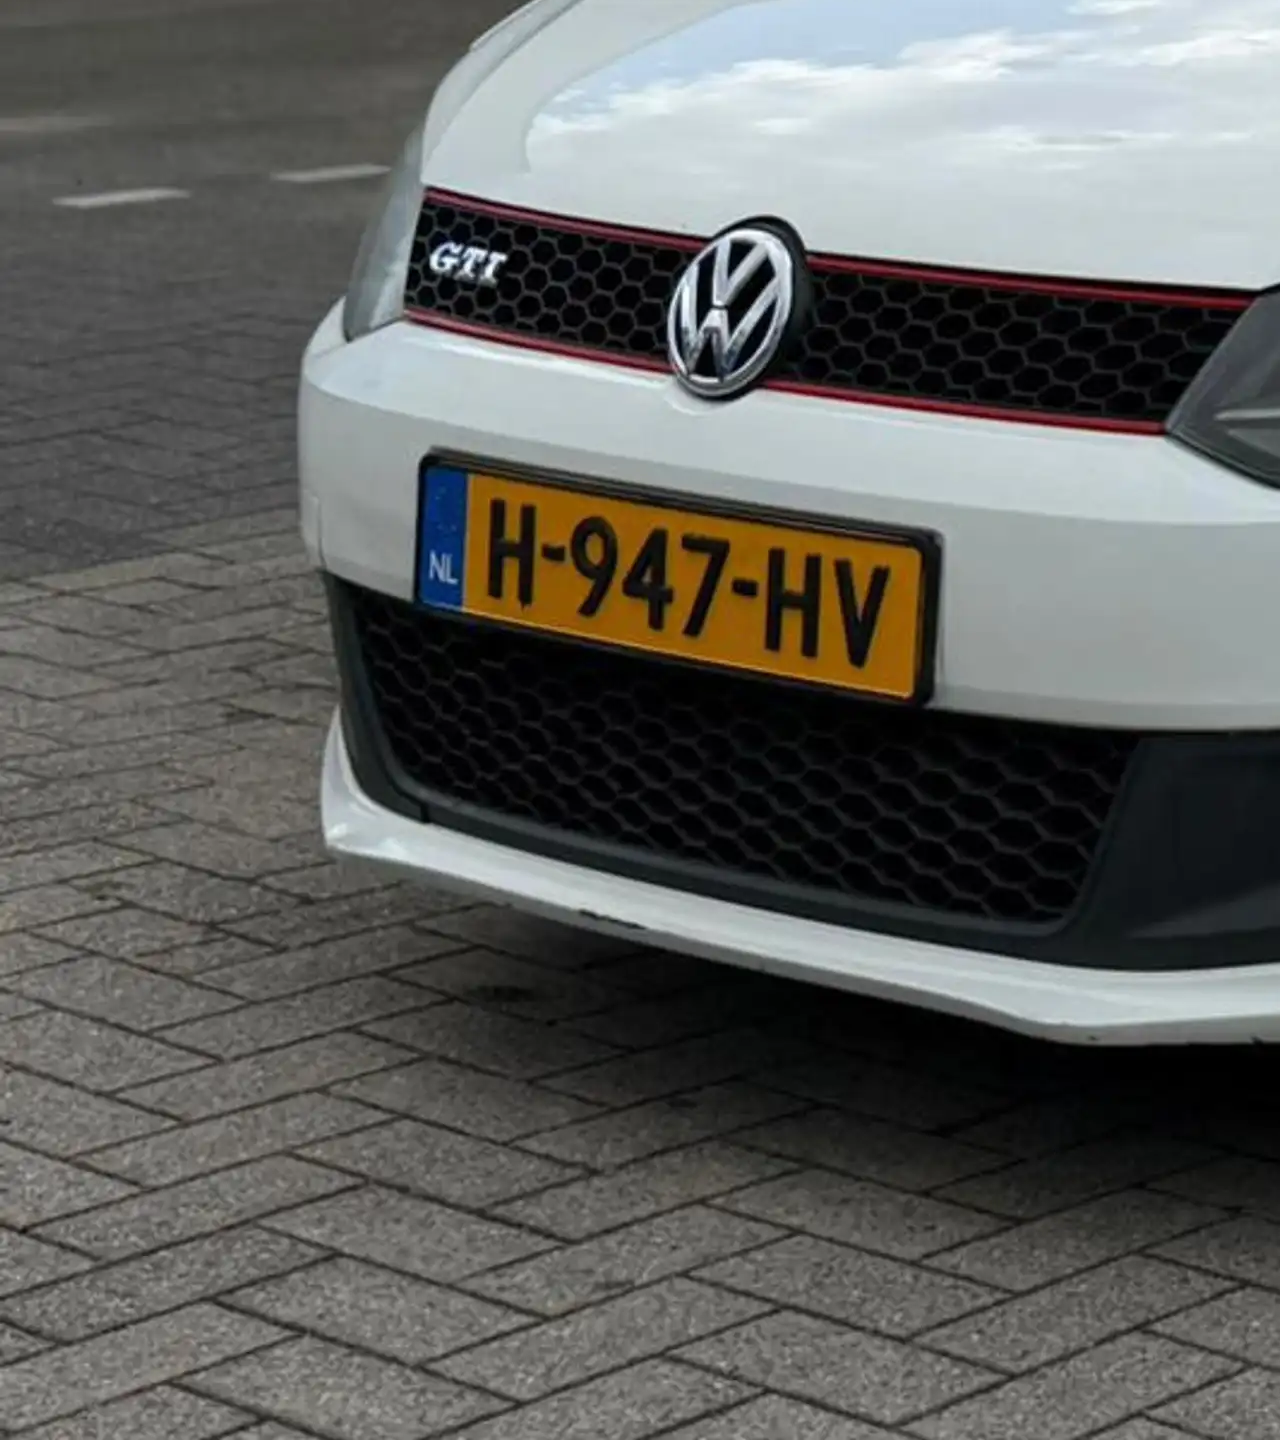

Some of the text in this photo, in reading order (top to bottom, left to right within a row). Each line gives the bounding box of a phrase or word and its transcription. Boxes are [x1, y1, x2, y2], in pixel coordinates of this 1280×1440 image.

[428, 240, 508, 288] GTI
[428, 550, 459, 586] NL
[487, 498, 891, 669] H-947-HV
